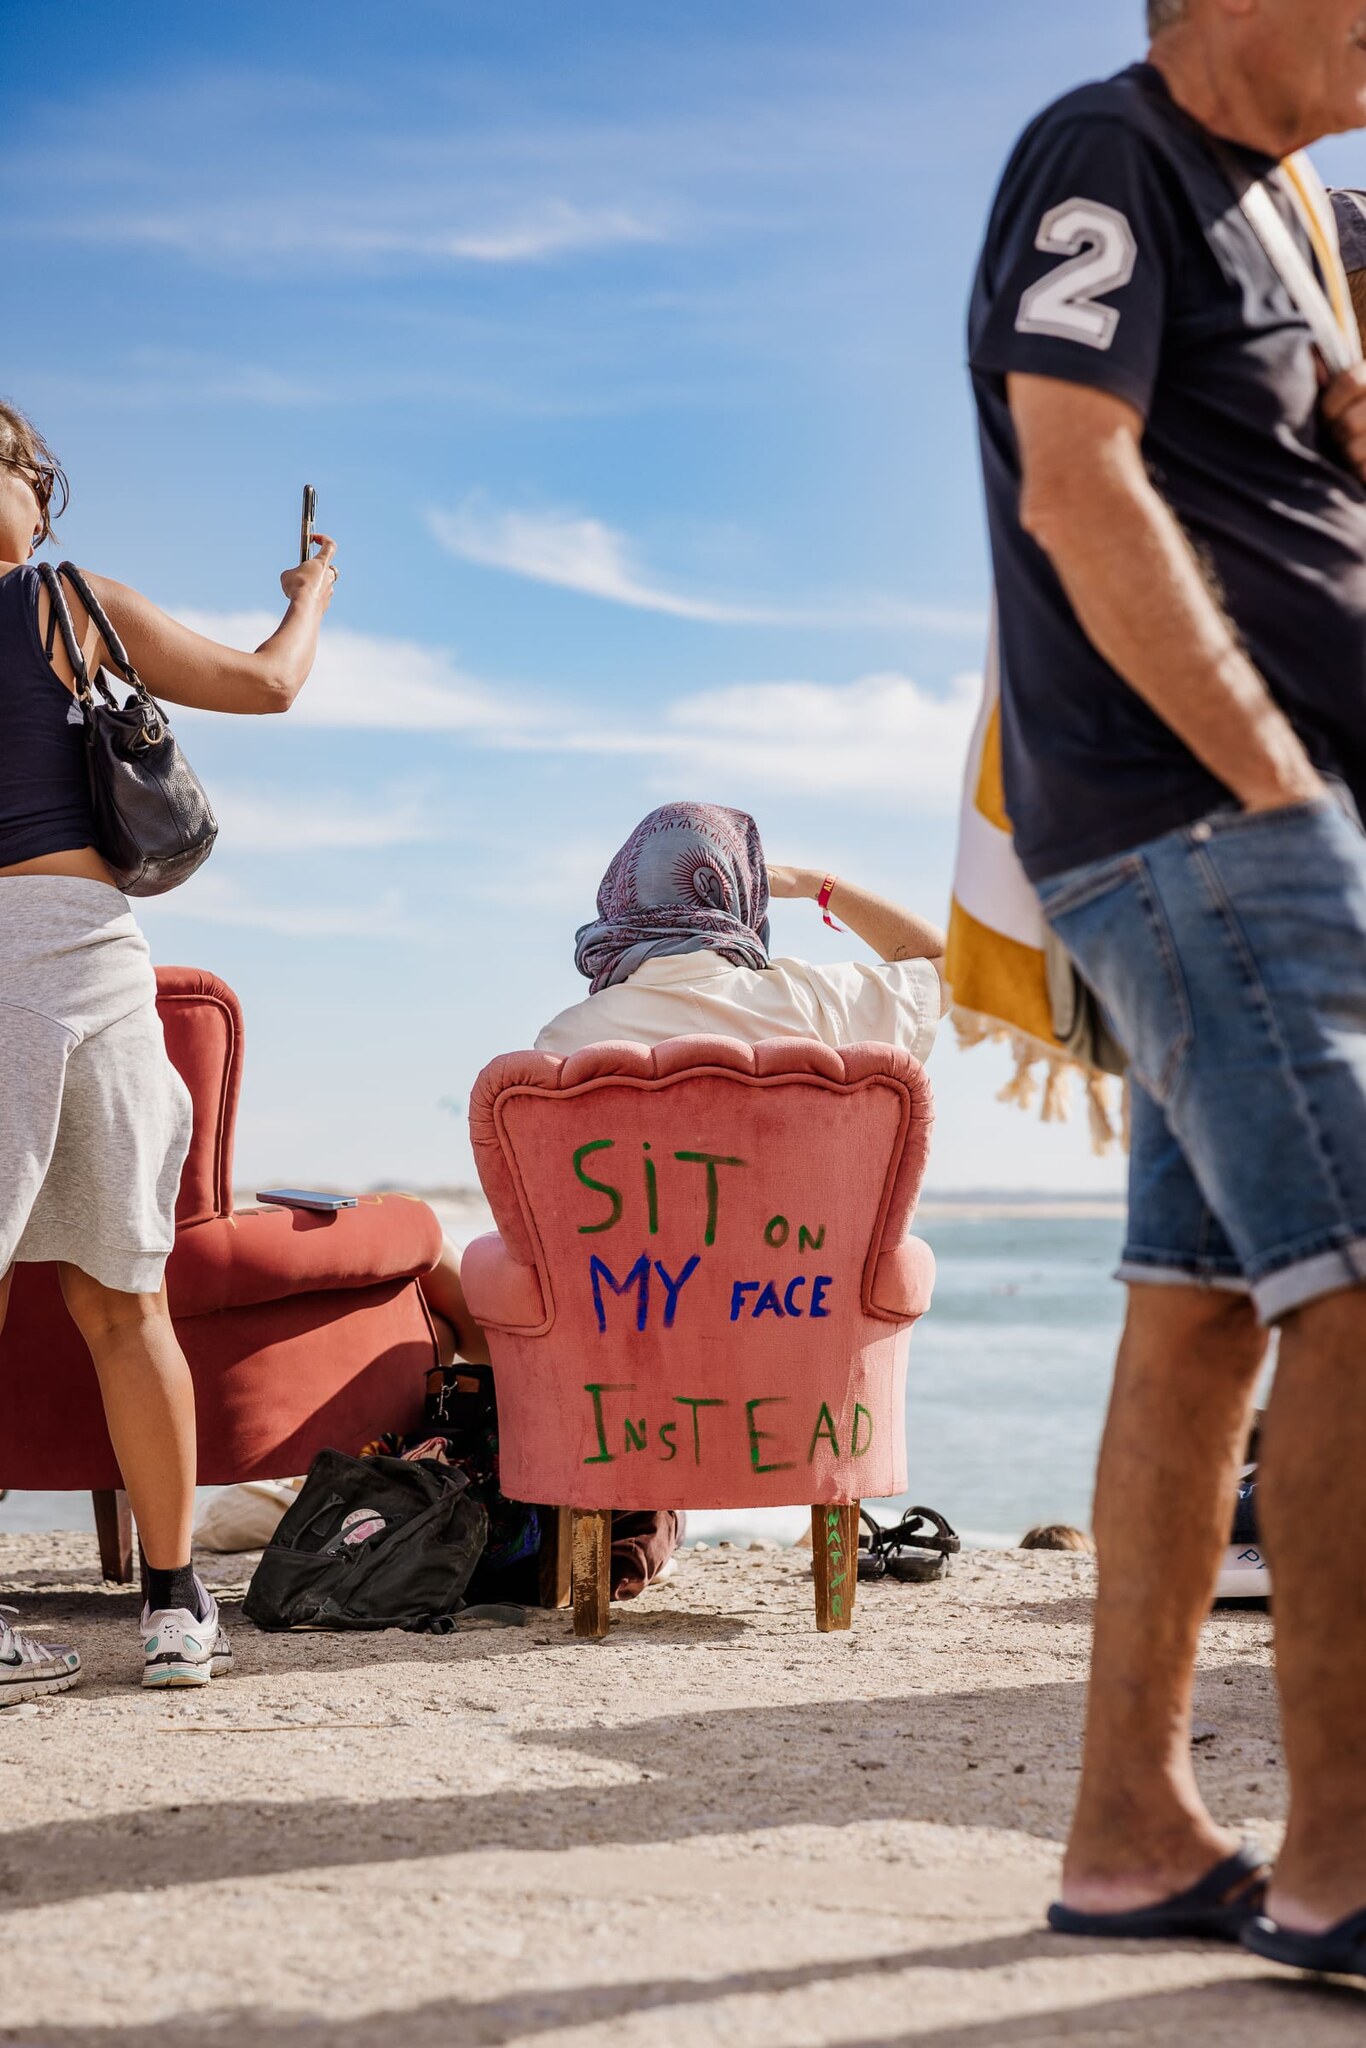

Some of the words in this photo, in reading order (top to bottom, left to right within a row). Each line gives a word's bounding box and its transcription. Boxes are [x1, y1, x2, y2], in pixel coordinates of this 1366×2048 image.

[1015, 196, 1138, 351] 2
[764, 1214, 827, 1253] ON
[589, 1250, 701, 1333] MY
[729, 1274, 833, 1321] FACE
